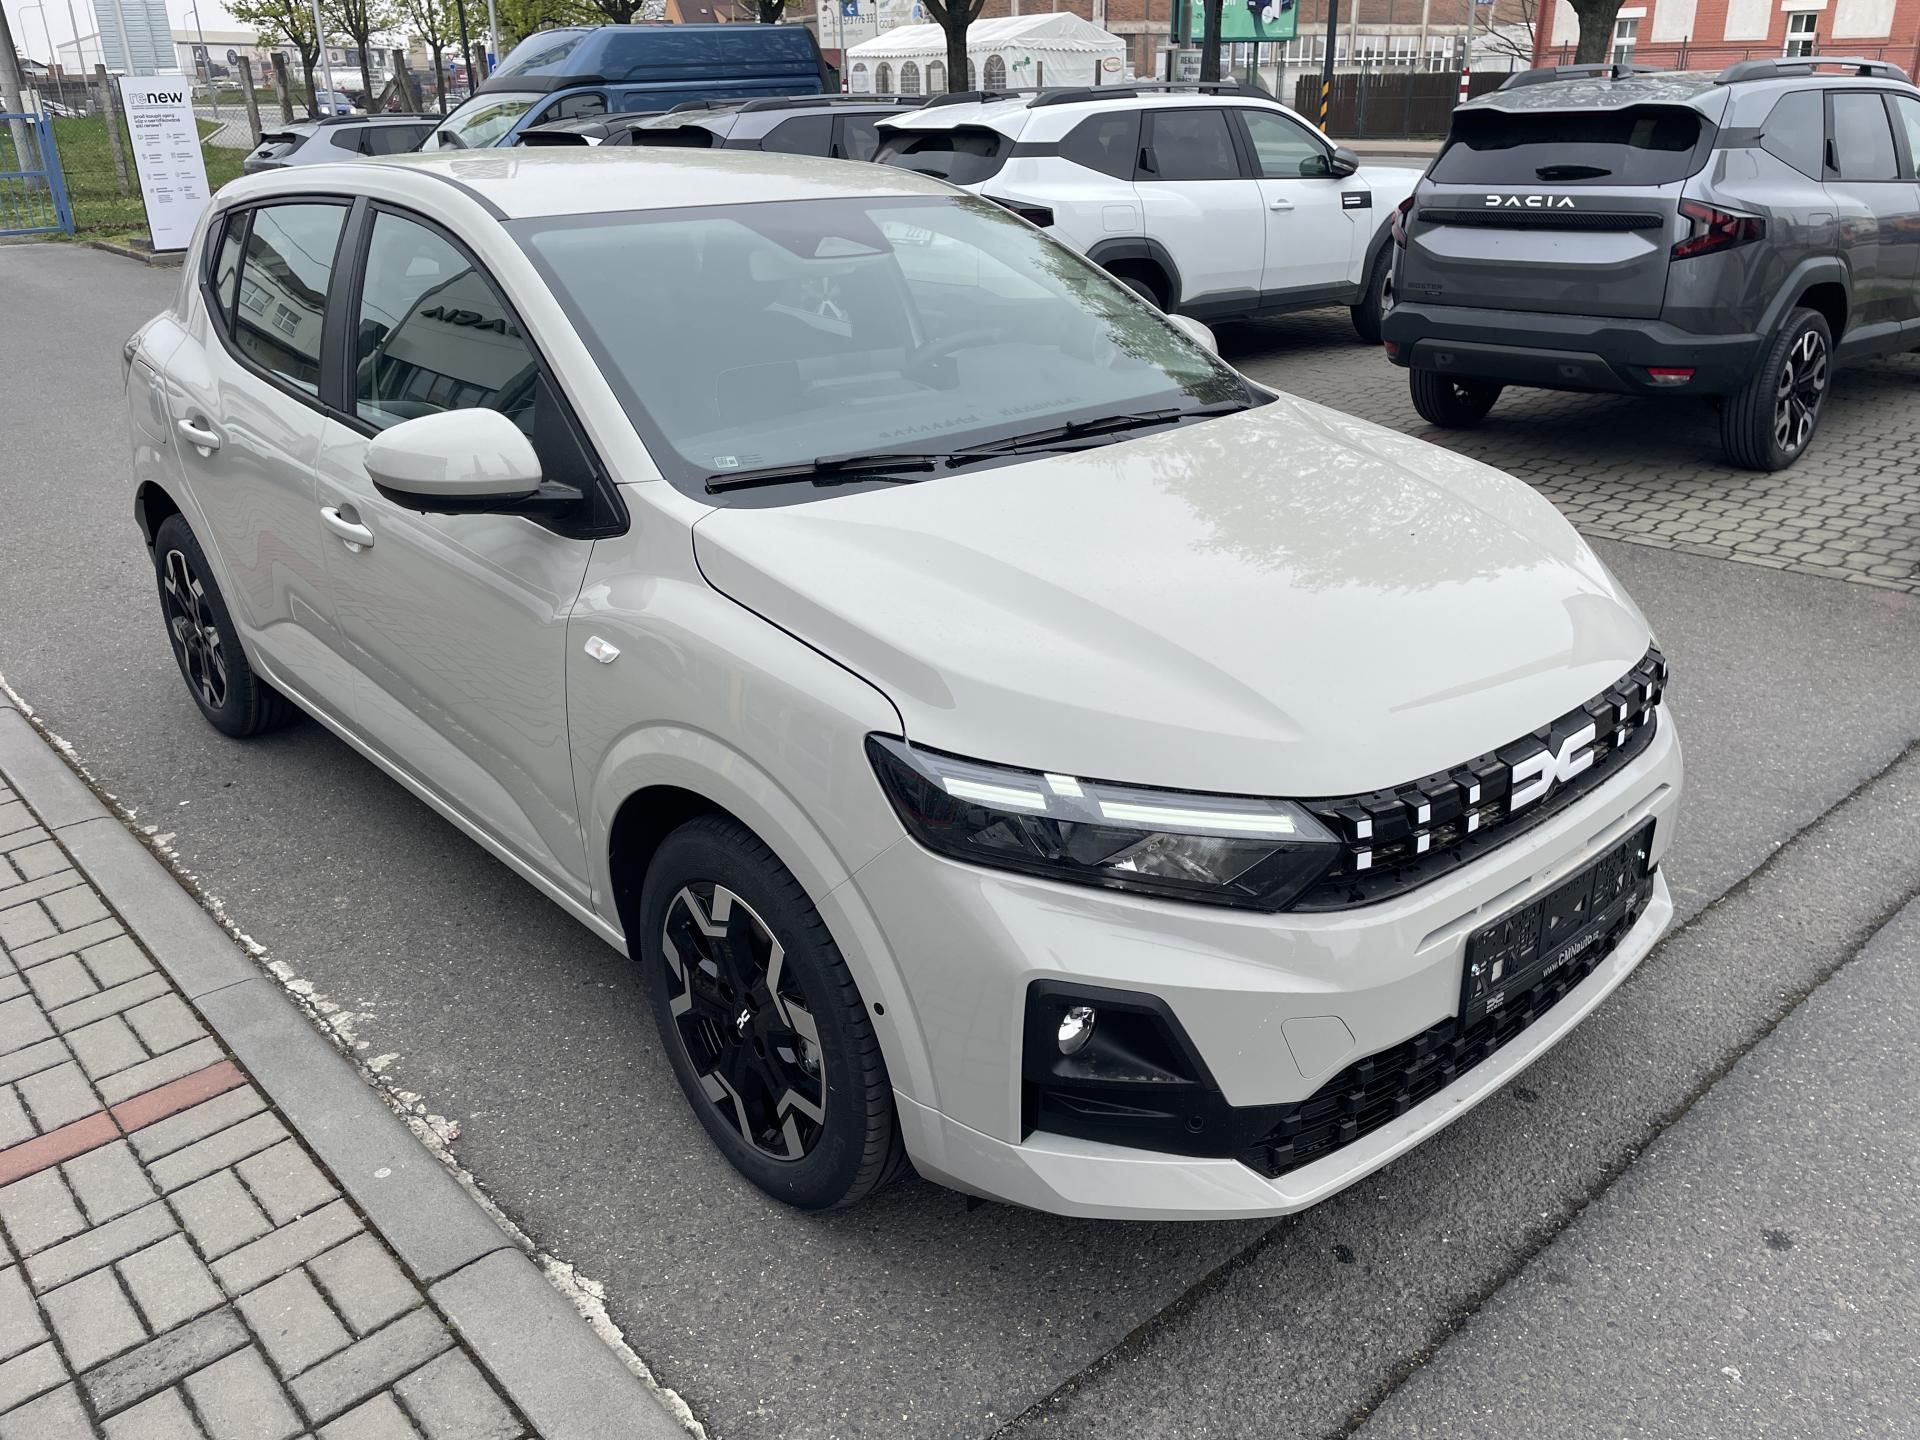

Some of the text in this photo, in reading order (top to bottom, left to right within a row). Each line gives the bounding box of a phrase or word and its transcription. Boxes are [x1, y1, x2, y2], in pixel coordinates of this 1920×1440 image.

[129, 92, 183, 104] renew
[1485, 194, 1576, 209] DACIA
[1542, 930, 1600, 977] www.CMNauto.cz
